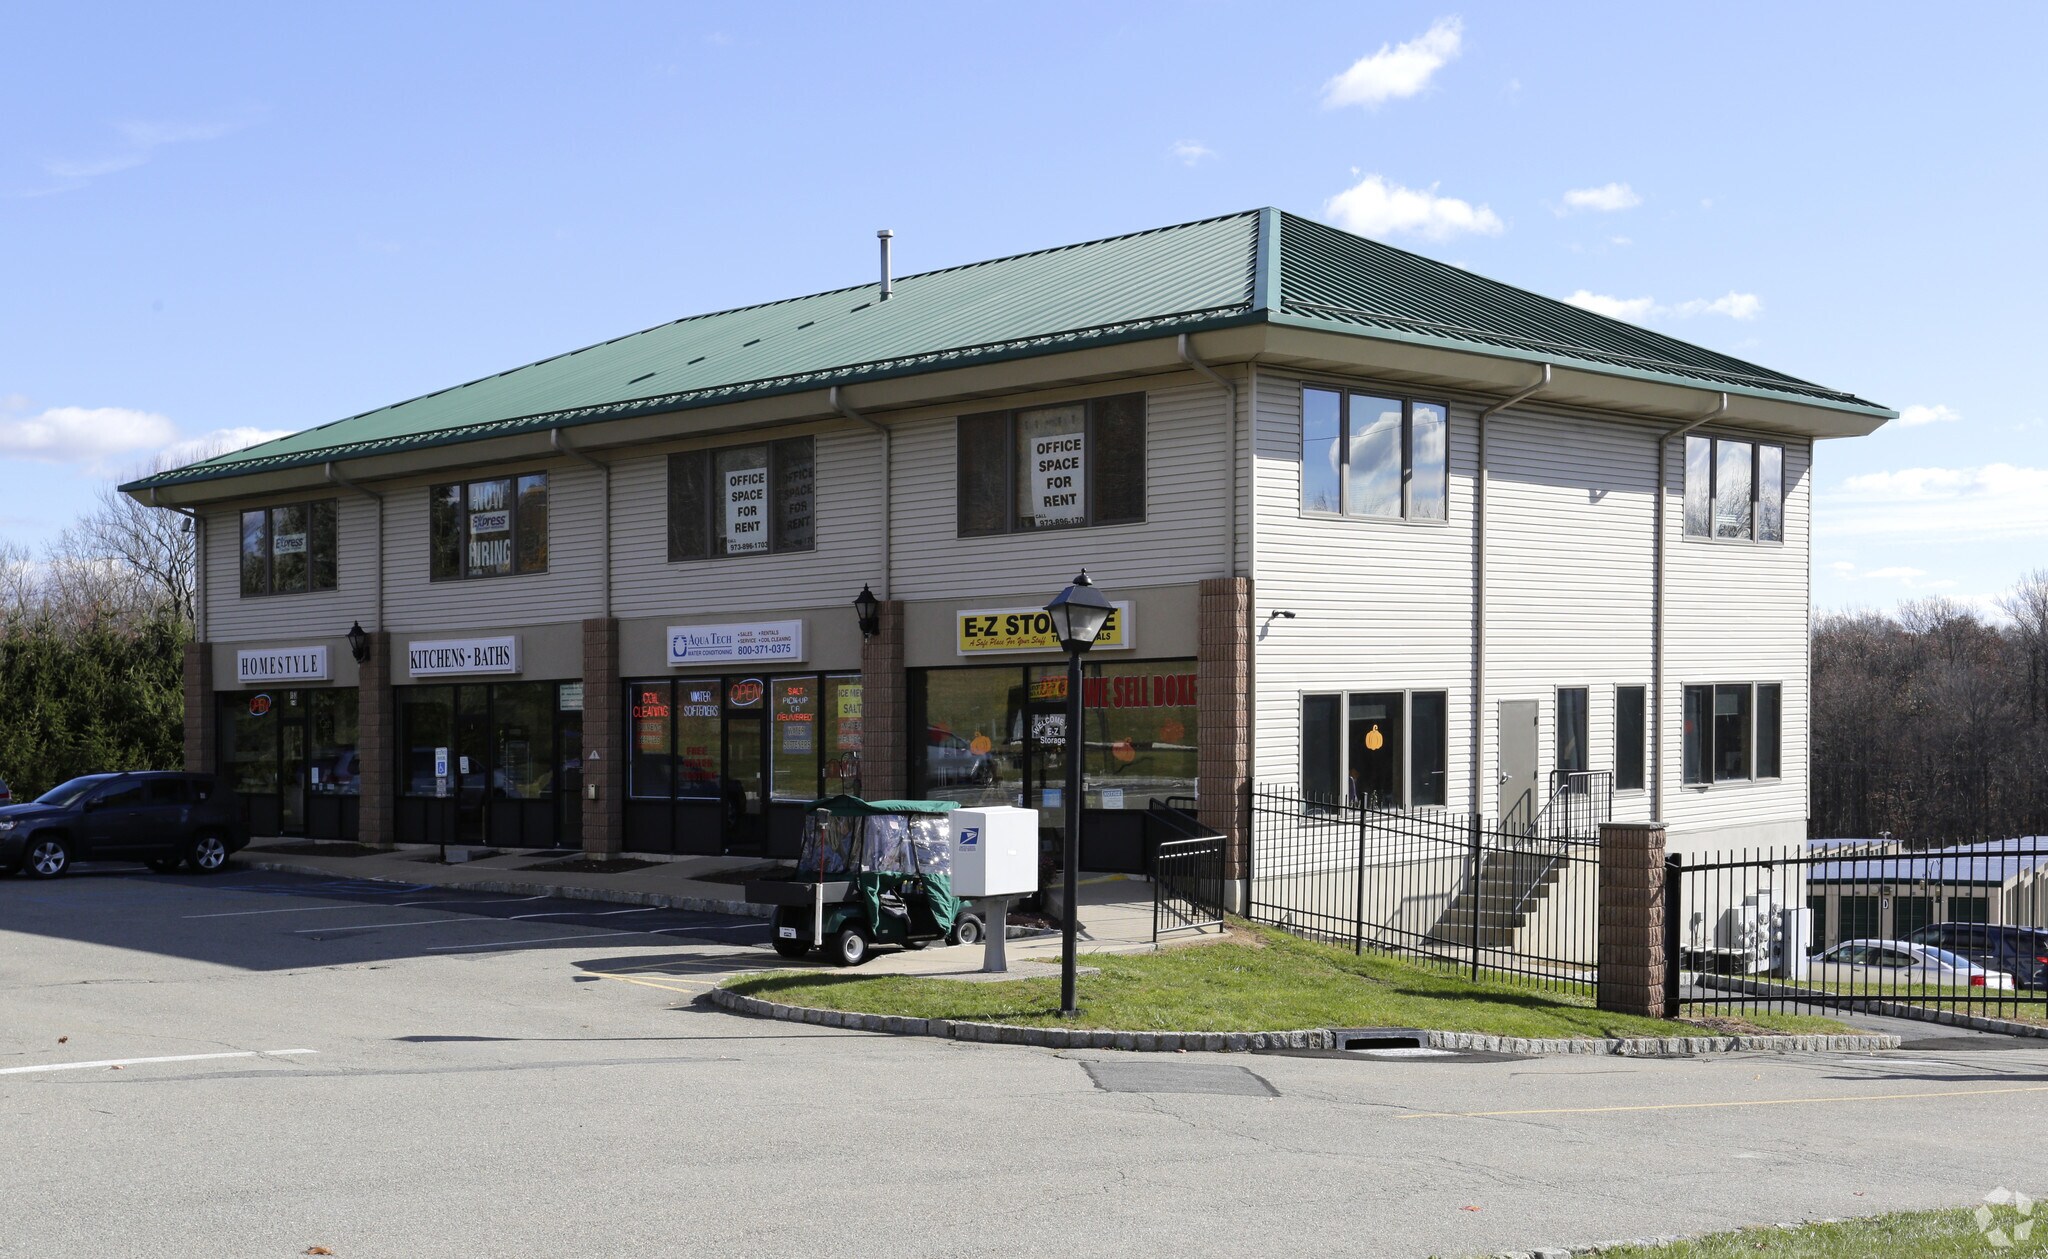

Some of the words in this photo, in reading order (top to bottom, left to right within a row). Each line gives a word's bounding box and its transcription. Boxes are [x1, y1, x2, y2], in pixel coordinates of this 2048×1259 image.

[1036, 439, 1081, 454] OFFICE
[1038, 457, 1079, 472] SPACE
[730, 473, 765, 487] OFFICE
[1046, 476, 1072, 489] FOR
[473, 484, 504, 511] NOW
[731, 489, 763, 502] SPACE
[1043, 493, 1077, 508] RENT
[737, 505, 757, 517] FOR
[735, 521, 761, 533] RENT
[469, 539, 511, 567] HIRING
[964, 616, 998, 638] E-Z
[976, 639, 989, 648] Safe
[989, 638, 1004, 646] Place
[1006, 637, 1015, 646] For
[1017, 636, 1030, 645] Your
[1031, 636, 1047, 645] Stuff
[738, 644, 791, 655] 800-371-0375
[410, 647, 465, 669] KITCHENS
[474, 645, 510, 666] BATHS
[241, 654, 318, 676] HOMESTYLE
[690, 690, 711, 702] WATER
[730, 683, 761, 701] OPEN
[787, 687, 804, 695] SALT
[838, 688, 848, 697] ICE
[1083, 676, 1109, 709] WE
[1113, 674, 1149, 709] SELL
[642, 692, 660, 704] COIL
[782, 696, 809, 705] PICK-UP
[632, 705, 669, 718] CLEANING
[683, 705, 719, 717] SOFTENERS
[843, 703, 862, 713] SALT
[777, 713, 814, 721] DELIVERED
[1033, 715, 1066, 735] WELCOME
[1039, 736, 1066, 745] Storage
